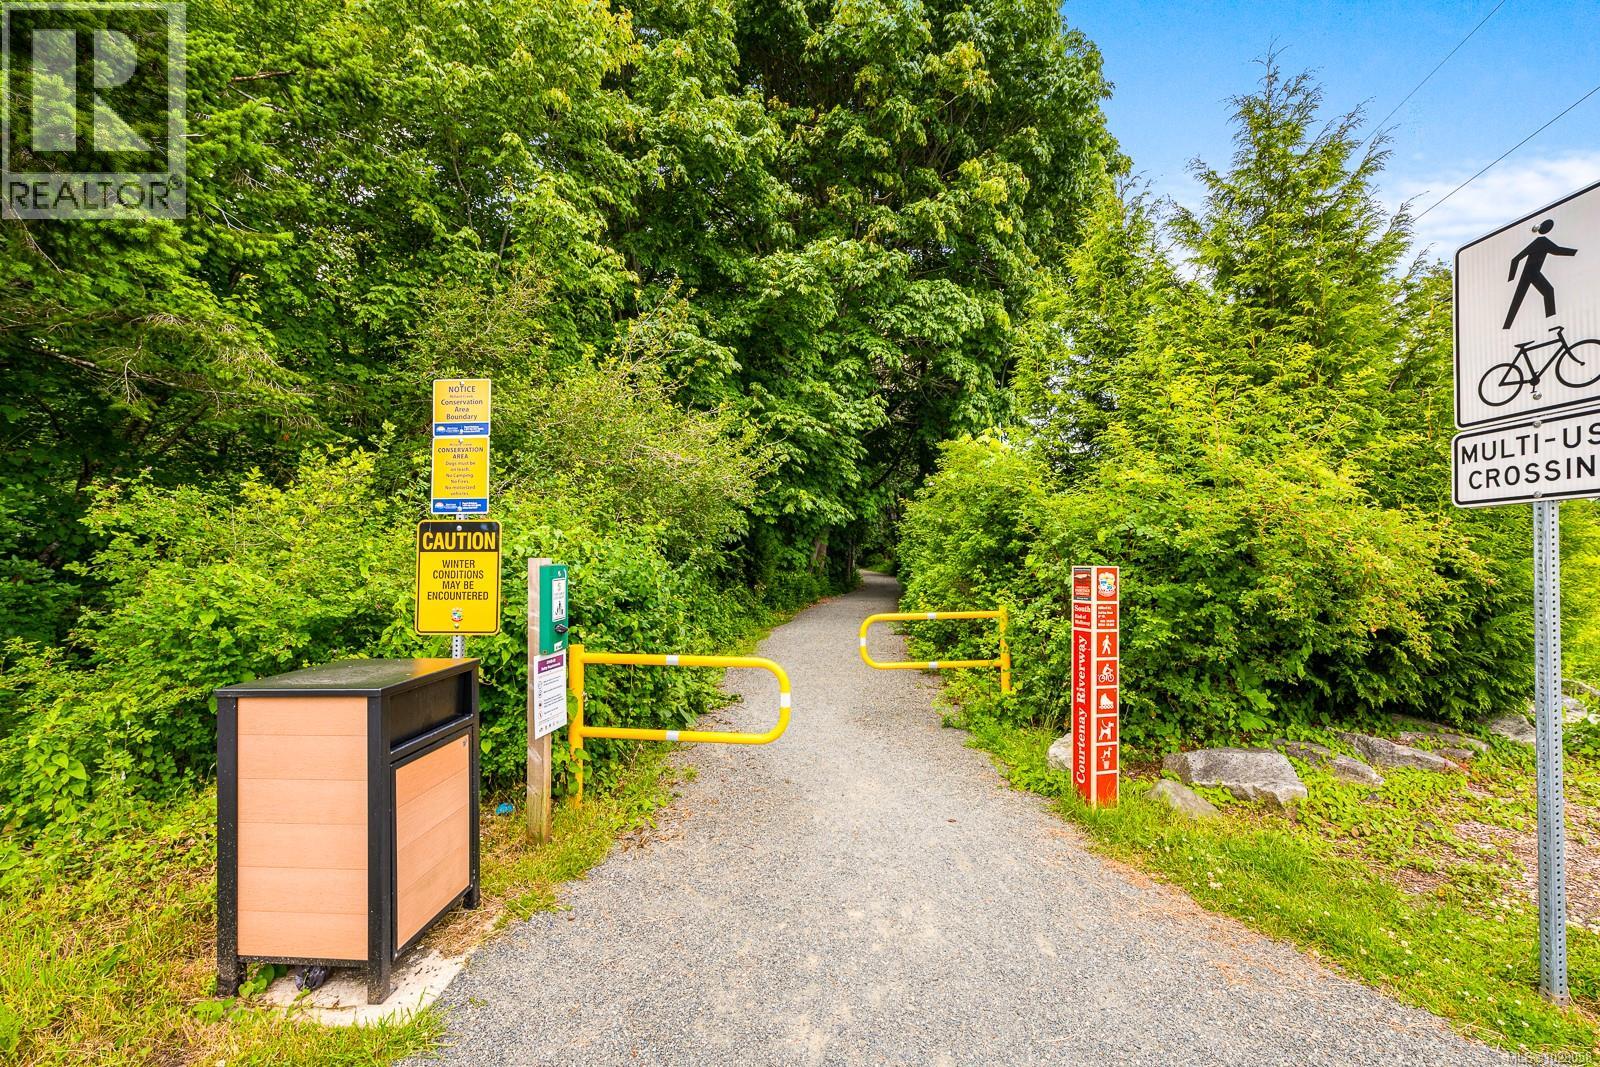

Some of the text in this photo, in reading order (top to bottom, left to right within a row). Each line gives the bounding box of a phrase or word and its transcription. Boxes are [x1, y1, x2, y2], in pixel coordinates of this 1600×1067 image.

[446, 413, 478, 421] Boundary
[422, 531, 496, 550] CAUTION
[442, 560, 475, 569] WINTER
[432, 570, 484, 579] CONDITIONS
[442, 581, 474, 590] MAY BE
[427, 591, 489, 601] ENCOUNTERED
[1074, 604, 1091, 613] South
[1076, 635, 1089, 784] Courtenay Riverway
